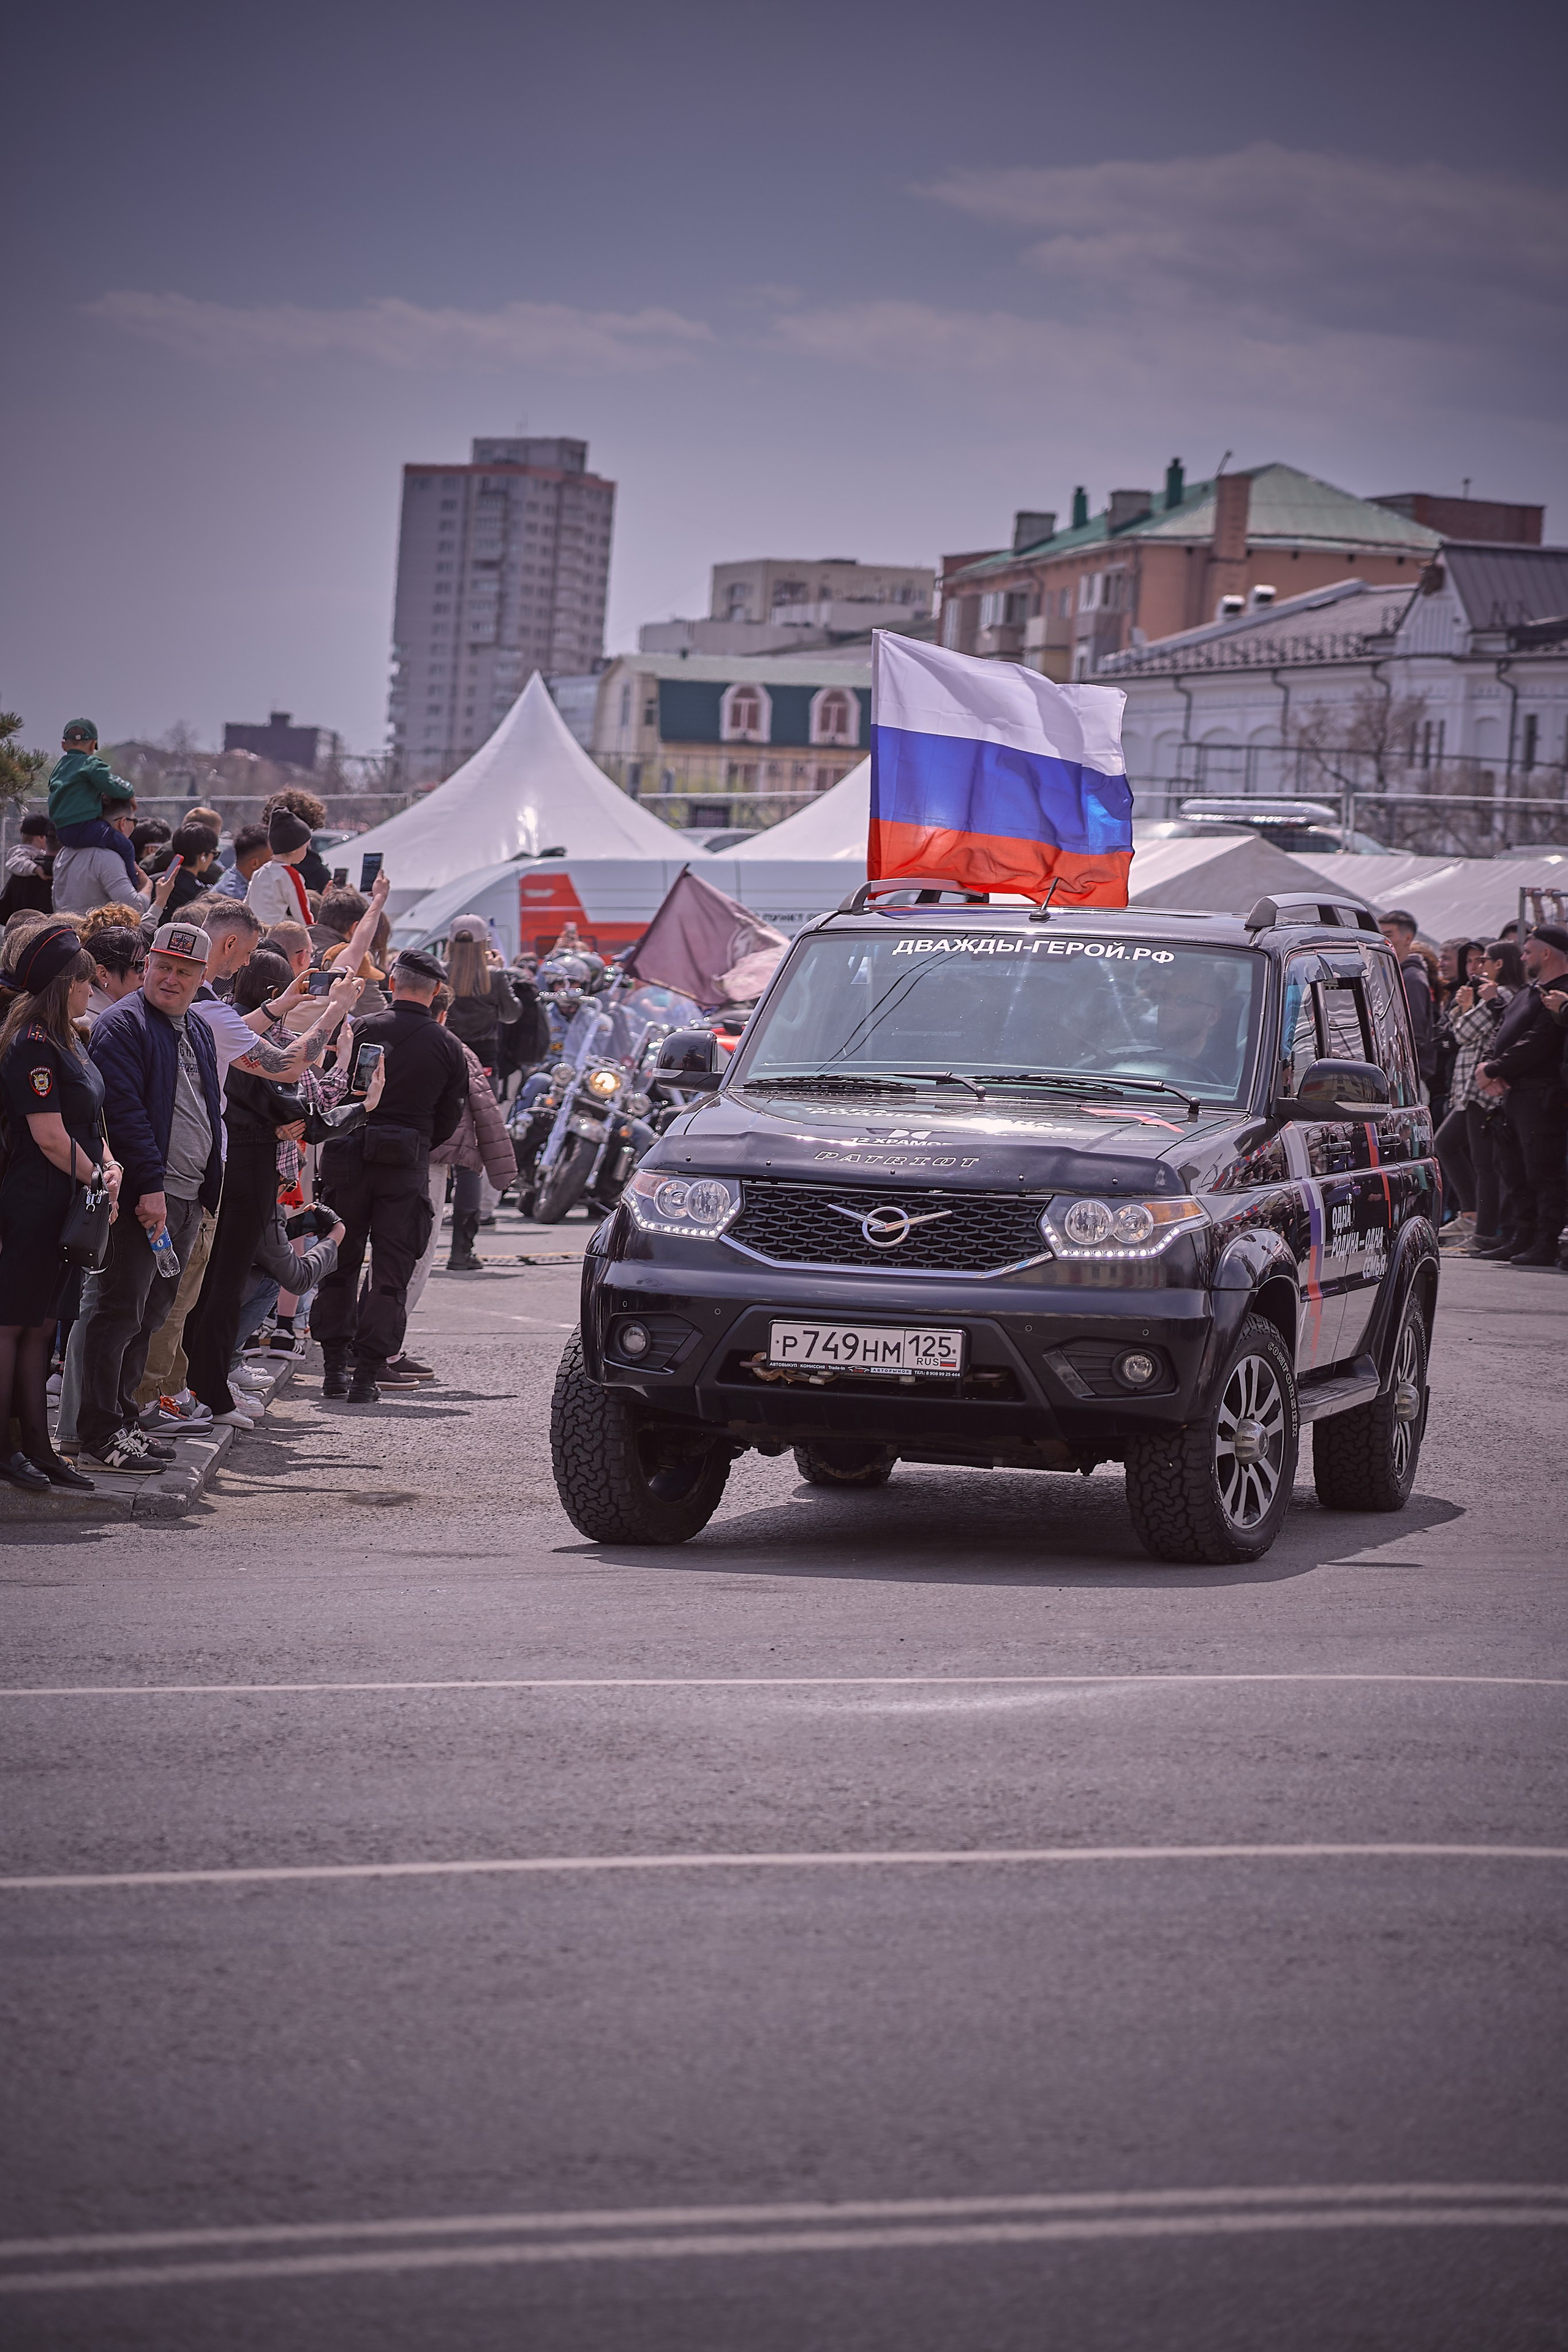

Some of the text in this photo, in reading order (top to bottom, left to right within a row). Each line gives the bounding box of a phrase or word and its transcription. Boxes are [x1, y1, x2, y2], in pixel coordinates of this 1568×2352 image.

[892, 939, 1175, 963] ДВАЖДЫ-ГЕРОЙ.РФ
[814, 1151, 979, 1167] PATRIOT
[1332, 1204, 1351, 1234] ОДНА
[1362, 1254, 1387, 1279] СЕМЬЯ
[908, 1335, 951, 1357] 125
[916, 1357, 939, 1366] RUS
